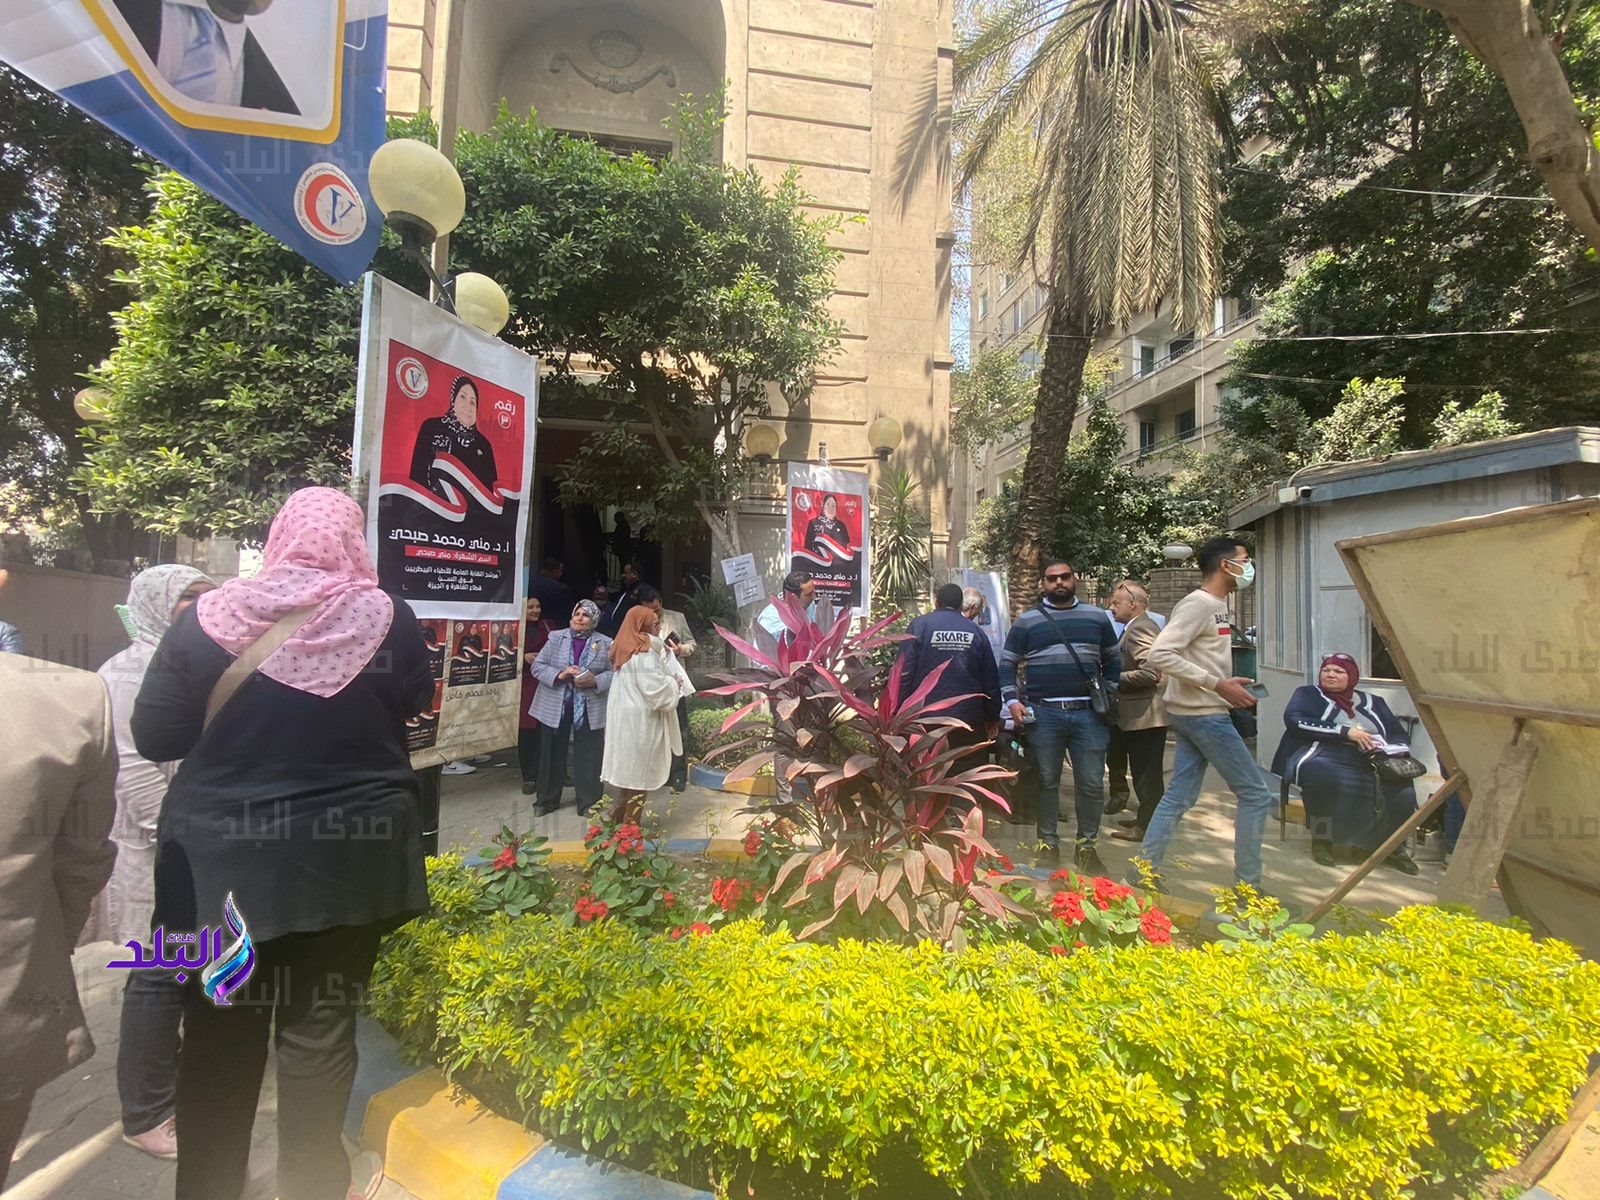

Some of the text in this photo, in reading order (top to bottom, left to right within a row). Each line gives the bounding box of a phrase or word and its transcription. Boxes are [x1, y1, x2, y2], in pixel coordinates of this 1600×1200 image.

[494, 399, 516, 416] رقم
[432, 532, 466, 548] محمد
[935, 632, 970, 642] SKARE
